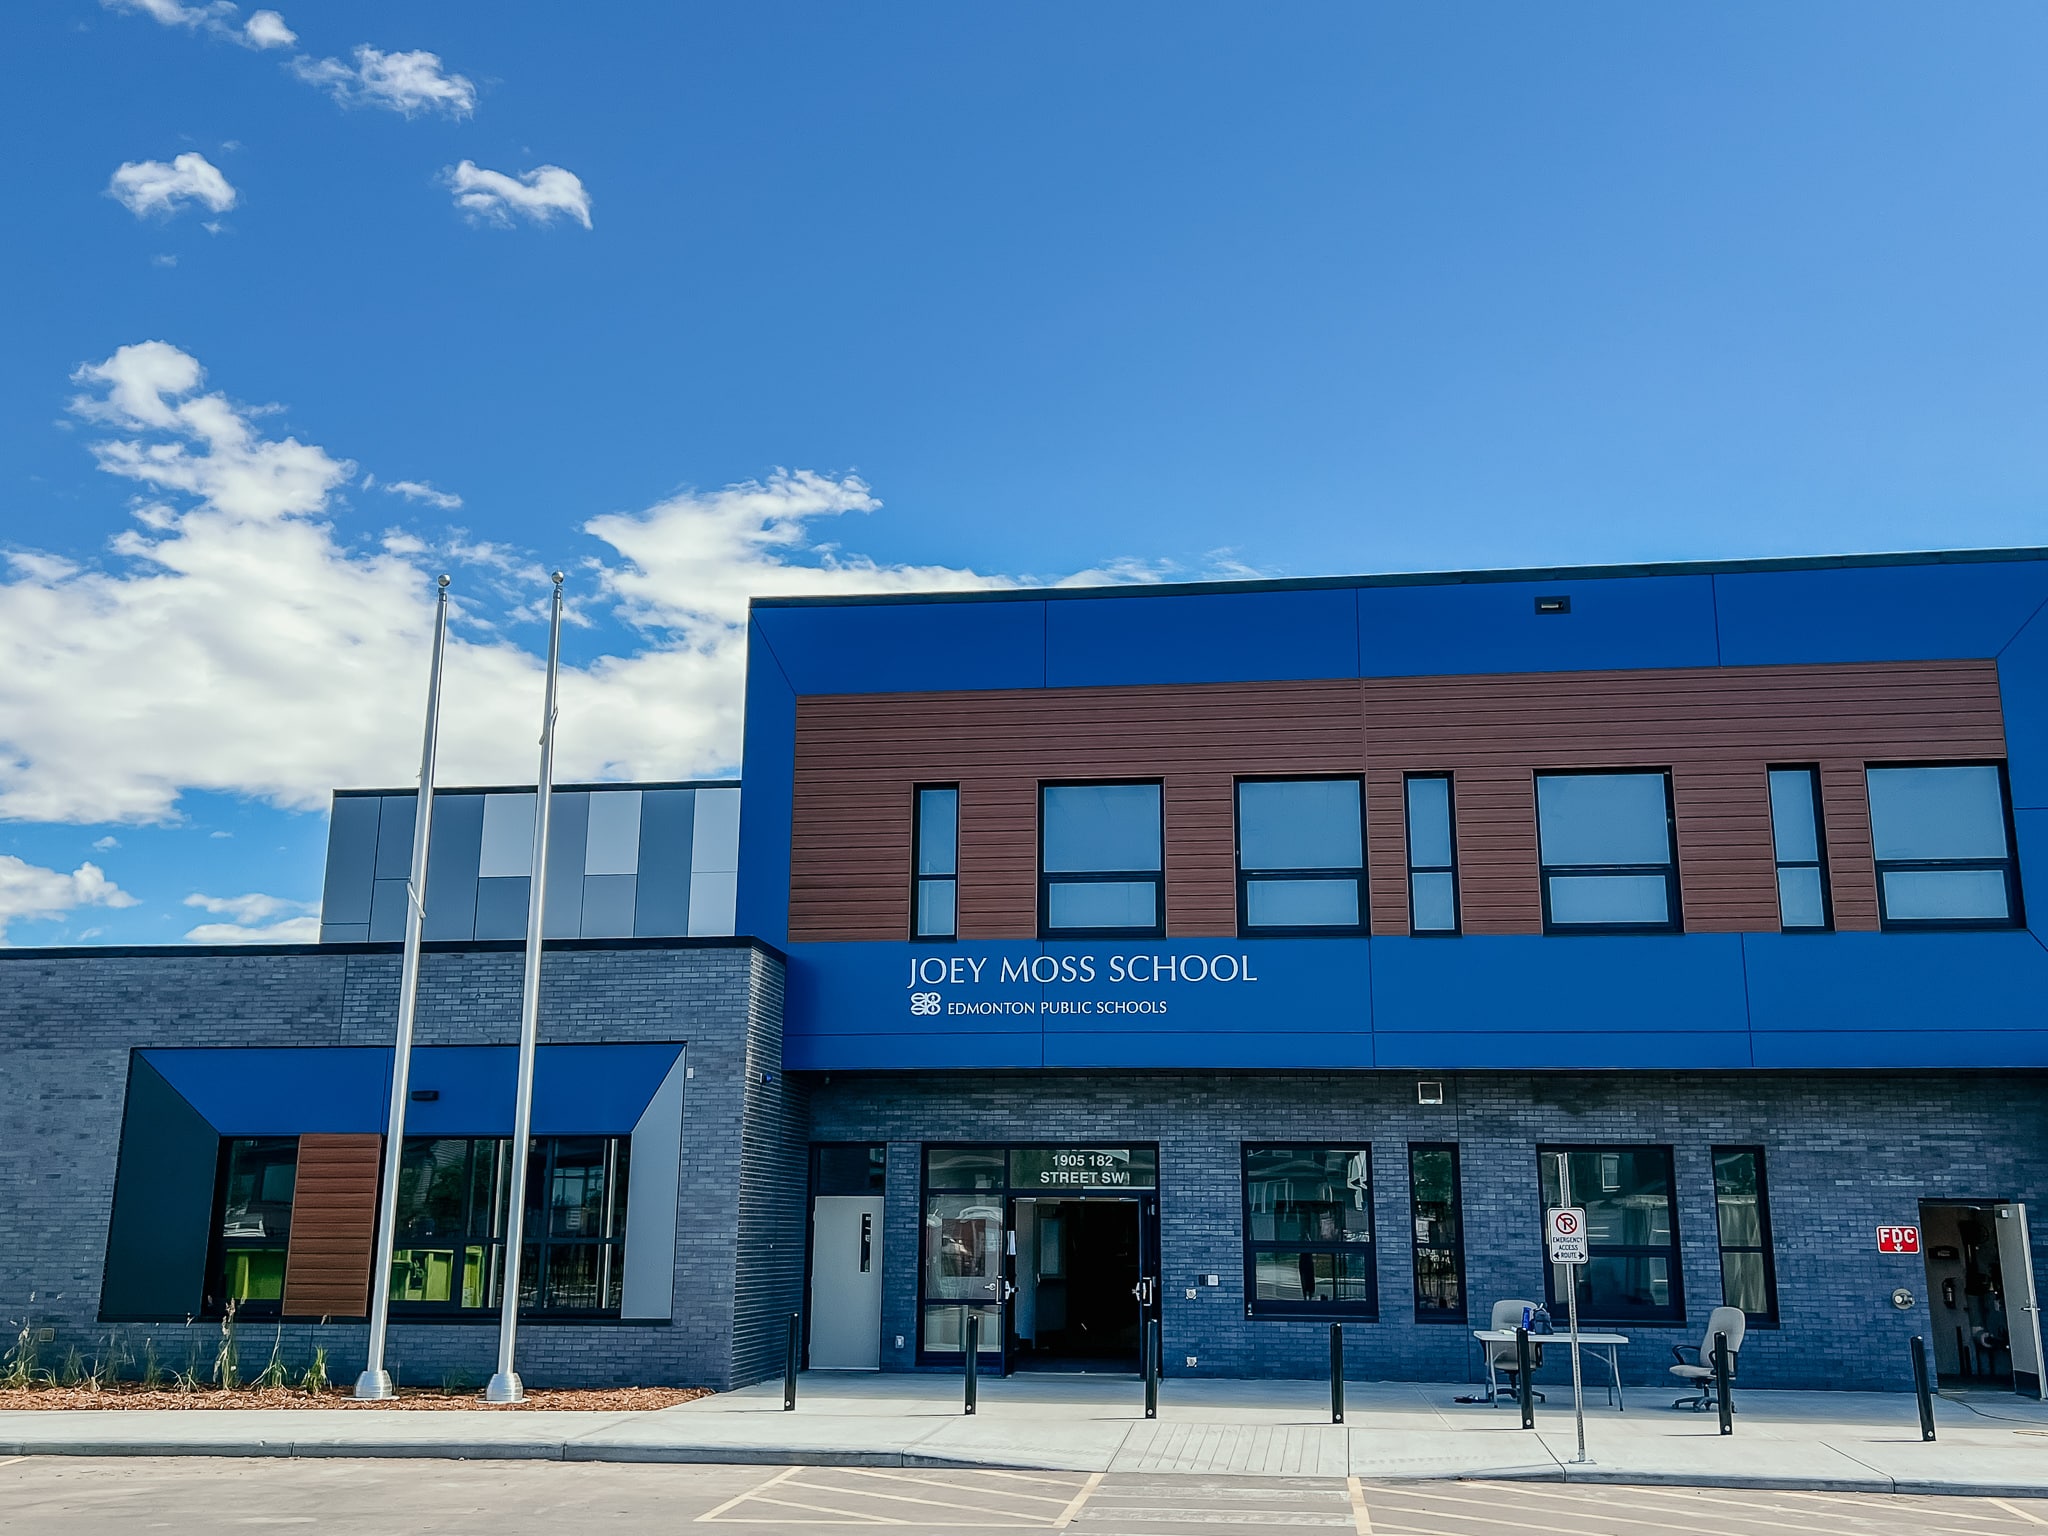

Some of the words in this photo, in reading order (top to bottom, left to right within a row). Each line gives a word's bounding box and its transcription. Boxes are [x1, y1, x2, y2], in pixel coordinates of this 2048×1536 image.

[907, 957, 987, 989] JOEY
[1000, 954, 1096, 983] MOSS
[1109, 954, 1258, 982] SCHOOL
[948, 1002, 1036, 1015] EDMONTON
[1041, 1002, 1091, 1014] PUBLIC
[1096, 1001, 1167, 1014] SCHOOLS
[1052, 1155, 1085, 1167] 1905
[1089, 1155, 1113, 1167] 182
[1040, 1171, 1098, 1184] STREET
[1101, 1171, 1125, 1184] SW
[1880, 1229, 1915, 1244] FDC
